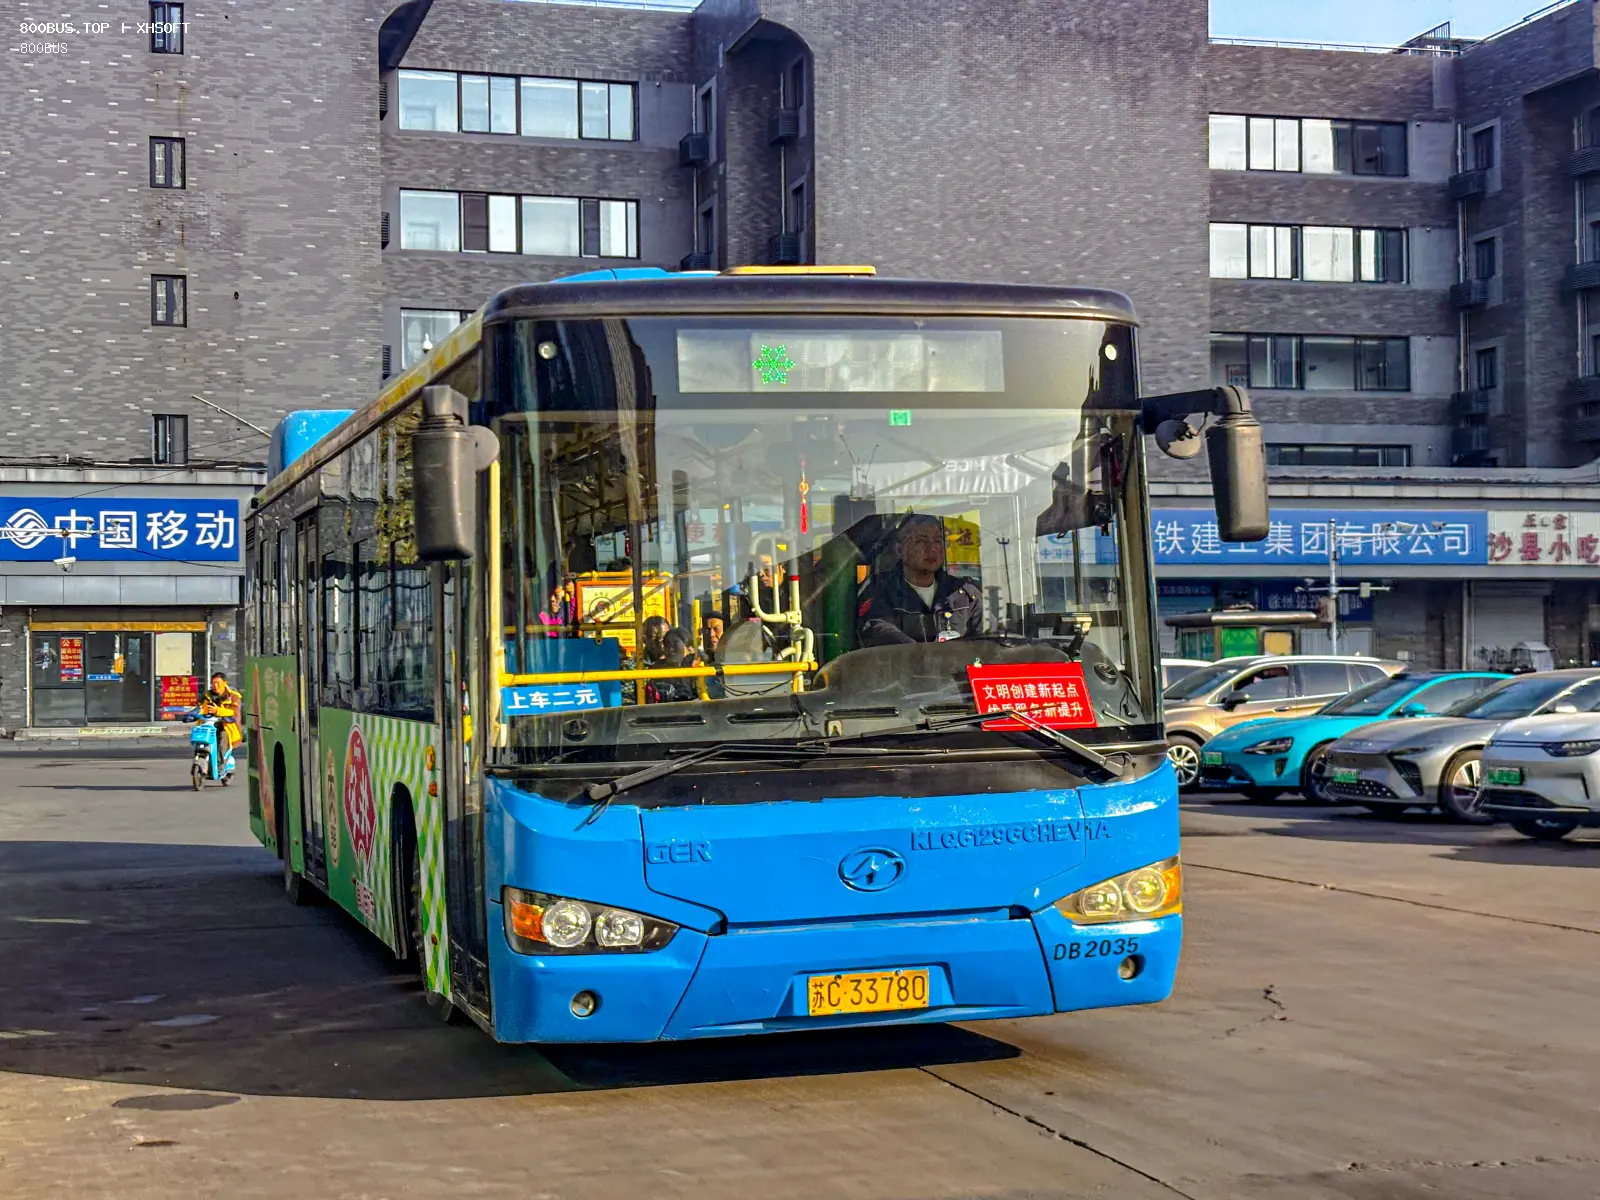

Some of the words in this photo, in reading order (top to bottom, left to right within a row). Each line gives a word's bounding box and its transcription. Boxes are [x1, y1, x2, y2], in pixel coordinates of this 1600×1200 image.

[54, 508, 235, 550] 中国移动
[1488, 531, 1600, 563] 沙县小吃
[507, 689, 598, 710] 上车二元
[981, 681, 1080, 700] 文明创建新起点
